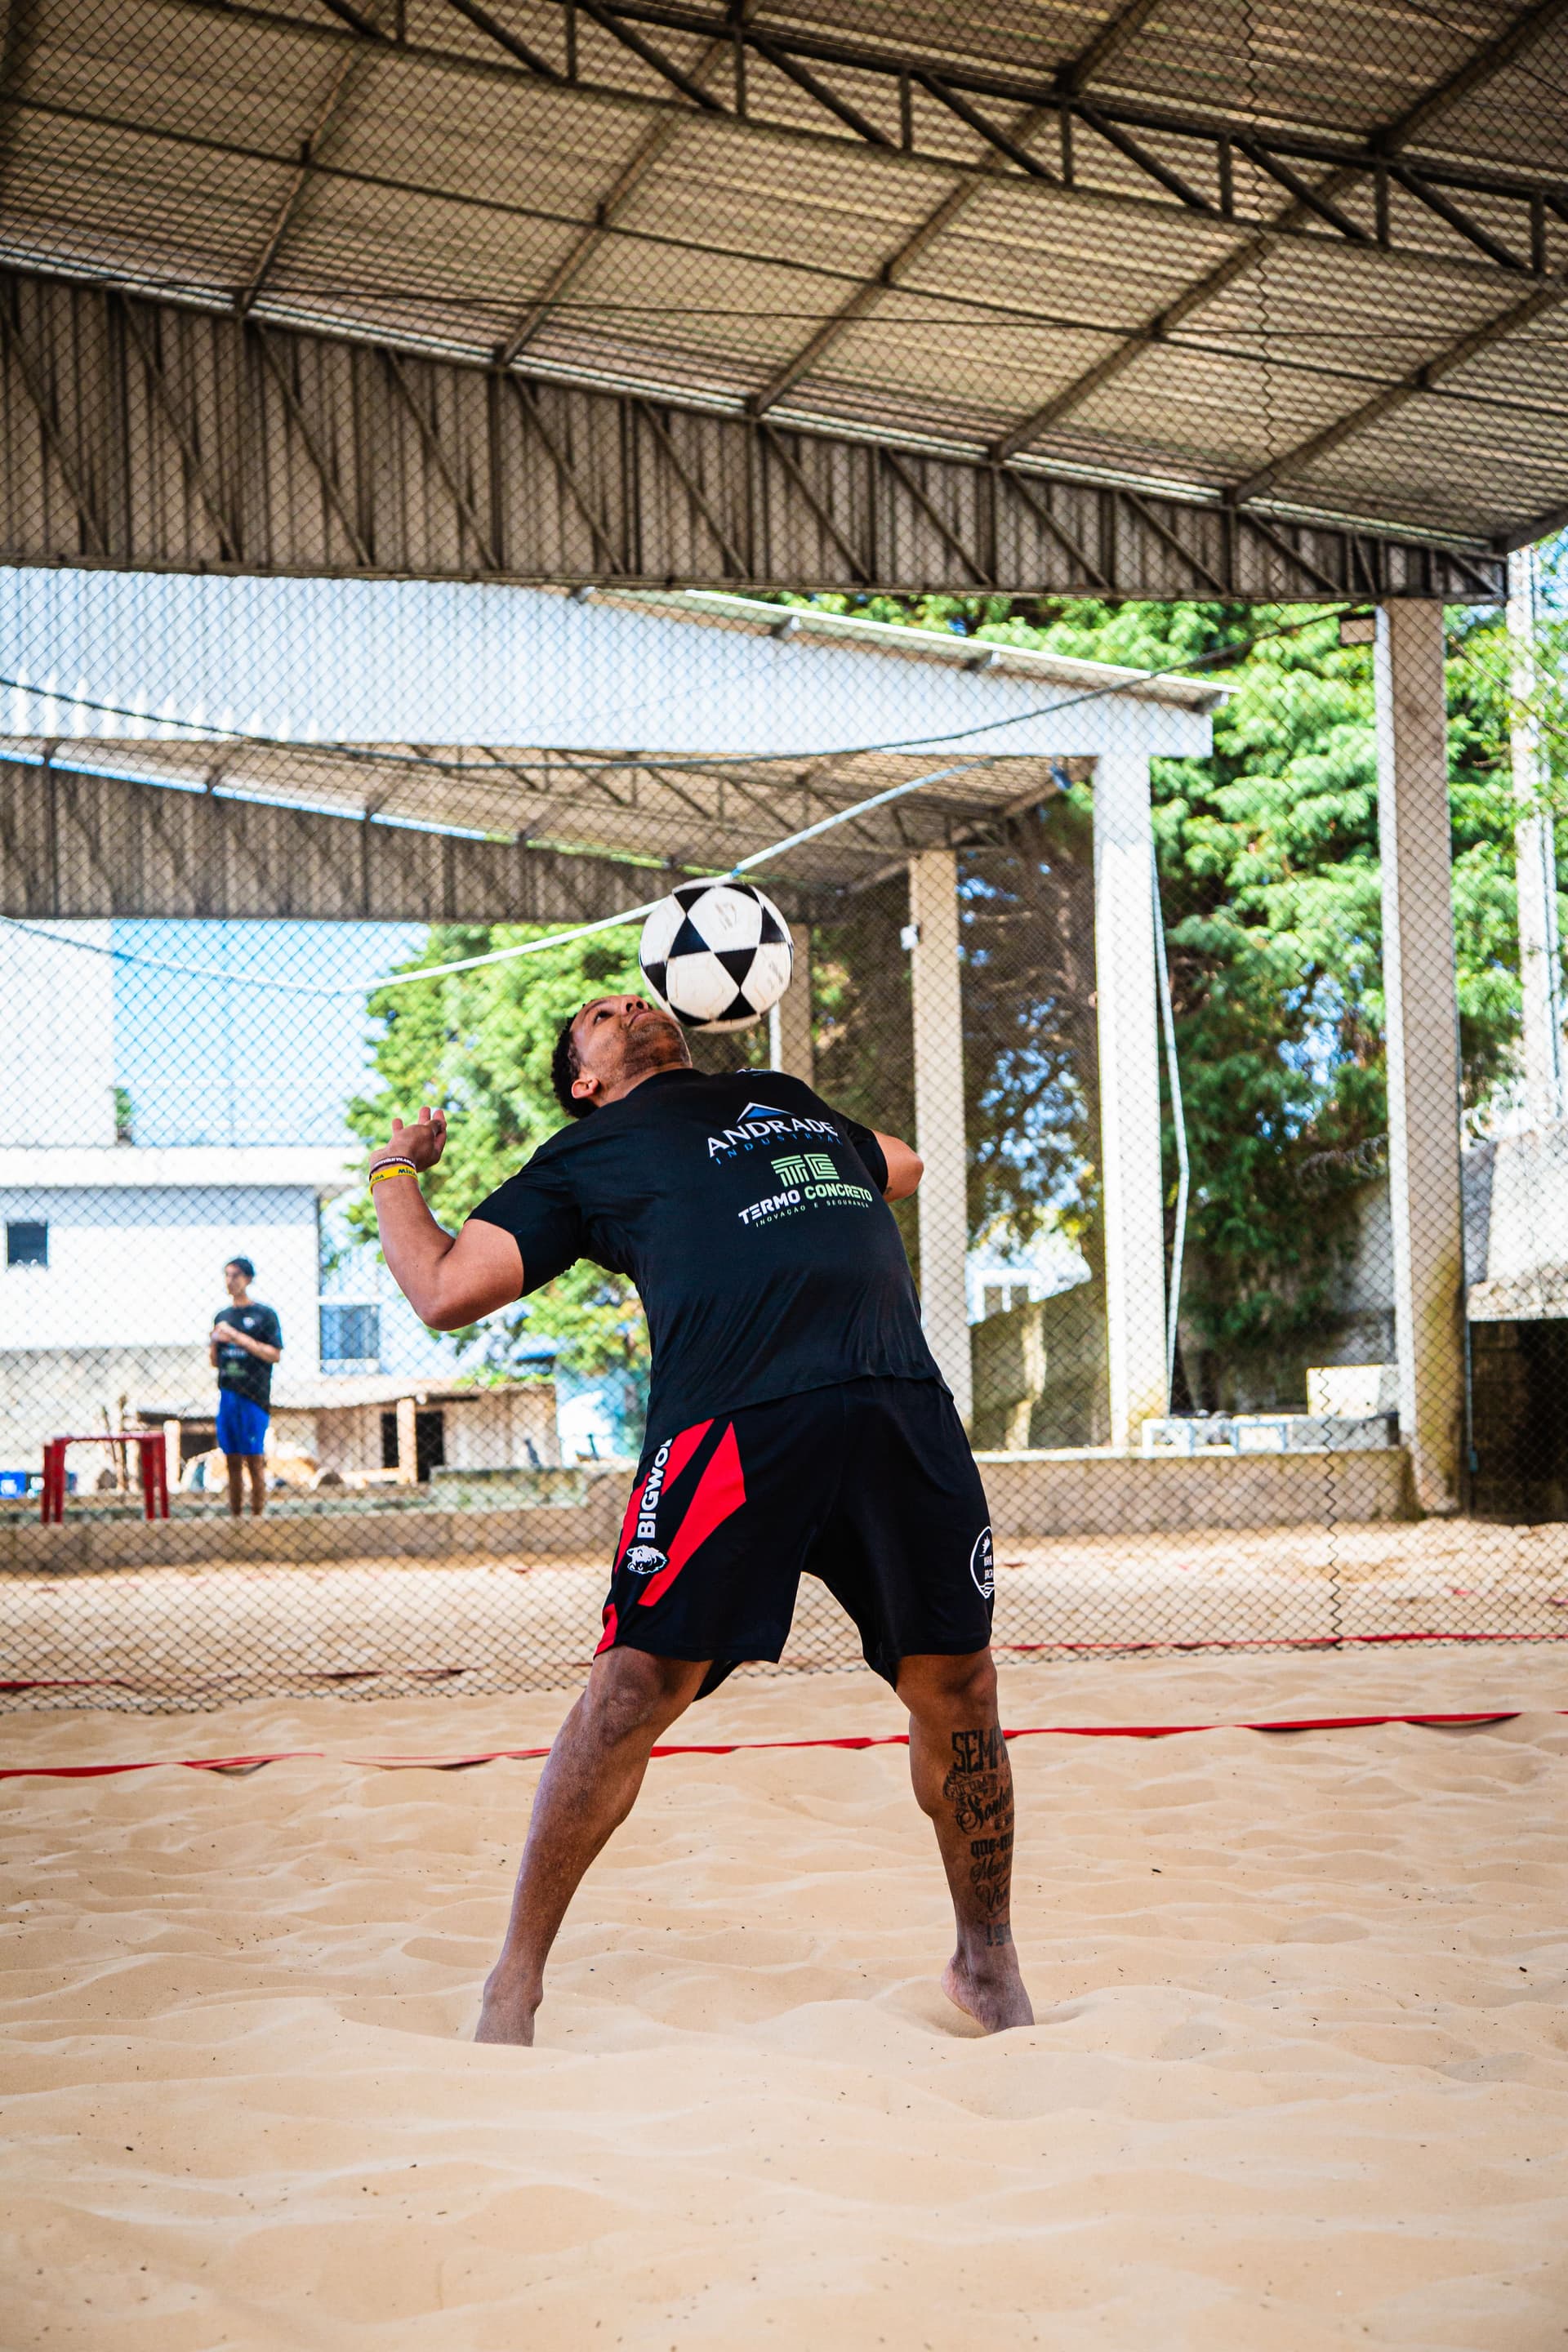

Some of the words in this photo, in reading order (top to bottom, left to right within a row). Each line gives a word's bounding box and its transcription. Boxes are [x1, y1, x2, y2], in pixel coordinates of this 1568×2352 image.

[707, 1118, 838, 1158] ANDRADE
[715, 1134, 843, 1165] INDUSTRIAL
[738, 1189, 800, 1225] TERMO
[804, 1183, 873, 1203] CONCRETO
[755, 1205, 806, 1227] INOVAÇÃO
